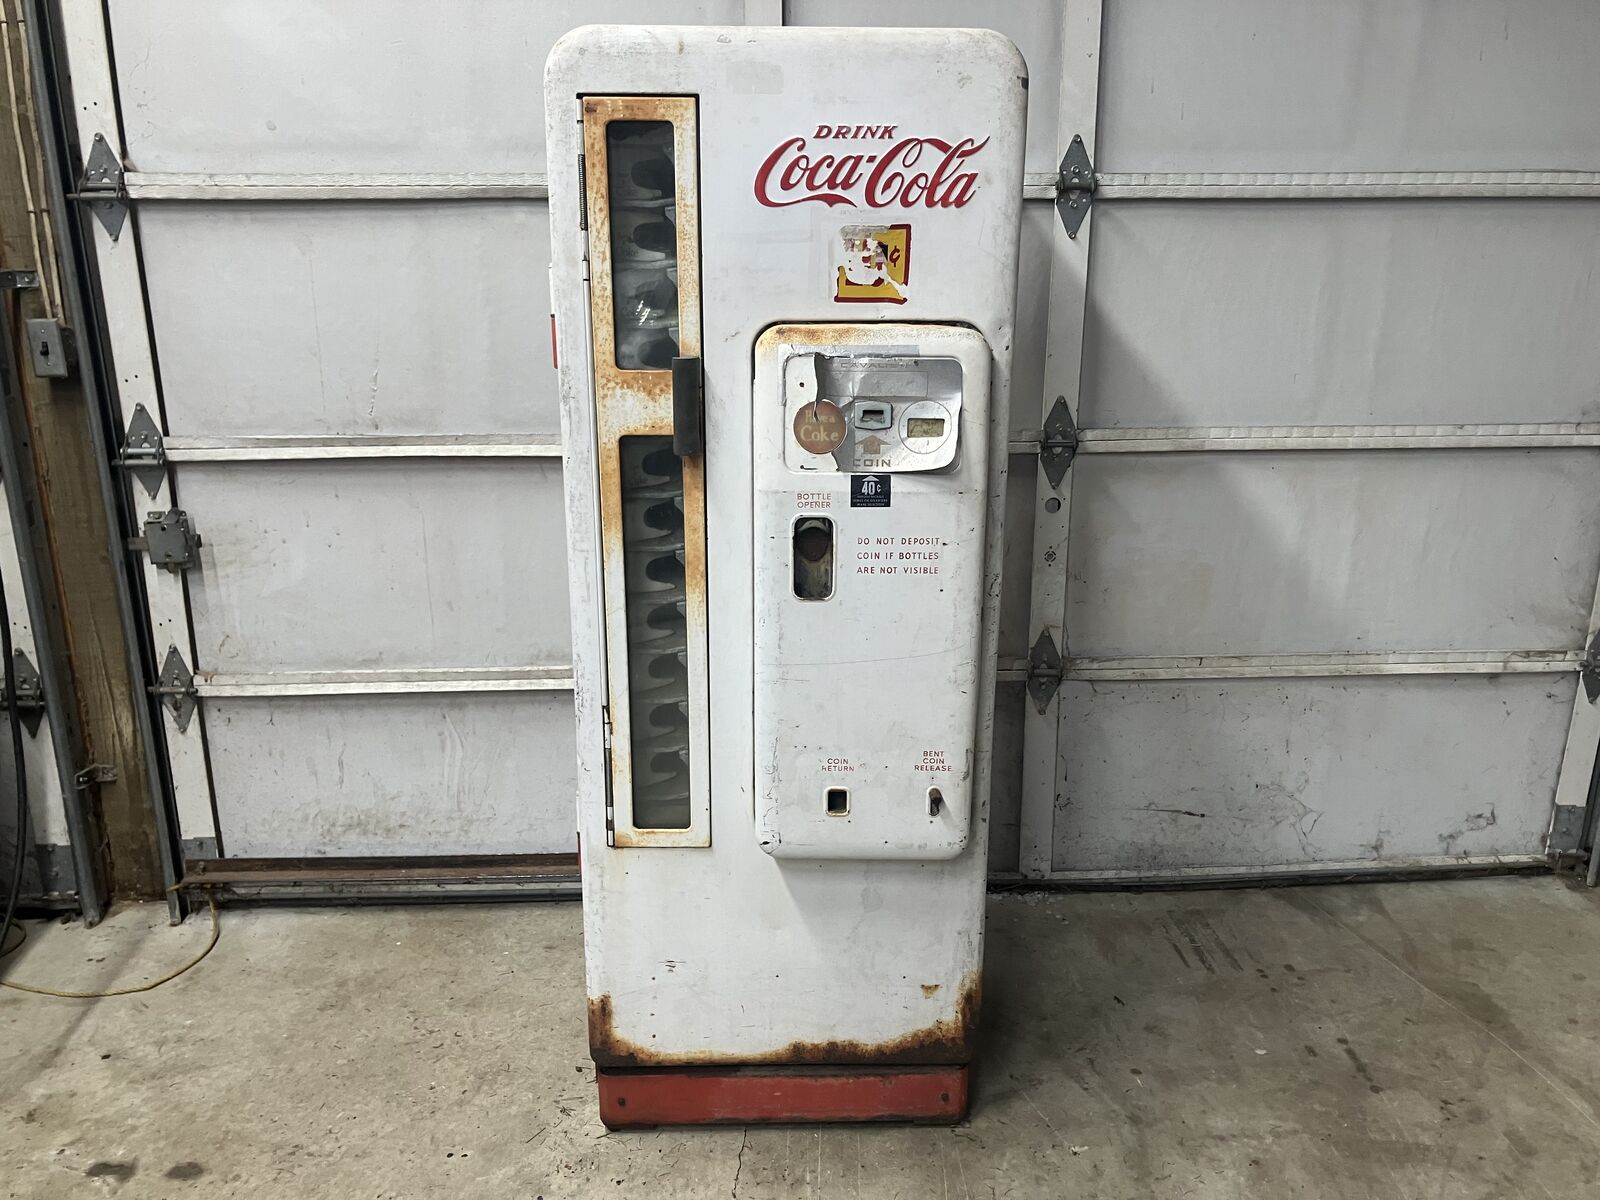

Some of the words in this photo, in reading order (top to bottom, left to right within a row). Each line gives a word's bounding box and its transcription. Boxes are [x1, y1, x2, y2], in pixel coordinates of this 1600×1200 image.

[813, 125, 898, 139] DRINK
[754, 136, 990, 208] Coca-Cola
[800, 425, 840, 442] Coke
[852, 459, 892, 468] COIN
[857, 537, 870, 545] DO
[876, 537, 895, 545] NOT
[901, 537, 940, 545] DEPOSIT
[857, 552, 880, 560] COIN
[885, 552, 894, 560] IF
[899, 552, 939, 560] BOTTLES
[856, 566, 875, 574] ARE
[880, 566, 897, 574] NOT
[903, 566, 939, 574] VISIBLE
